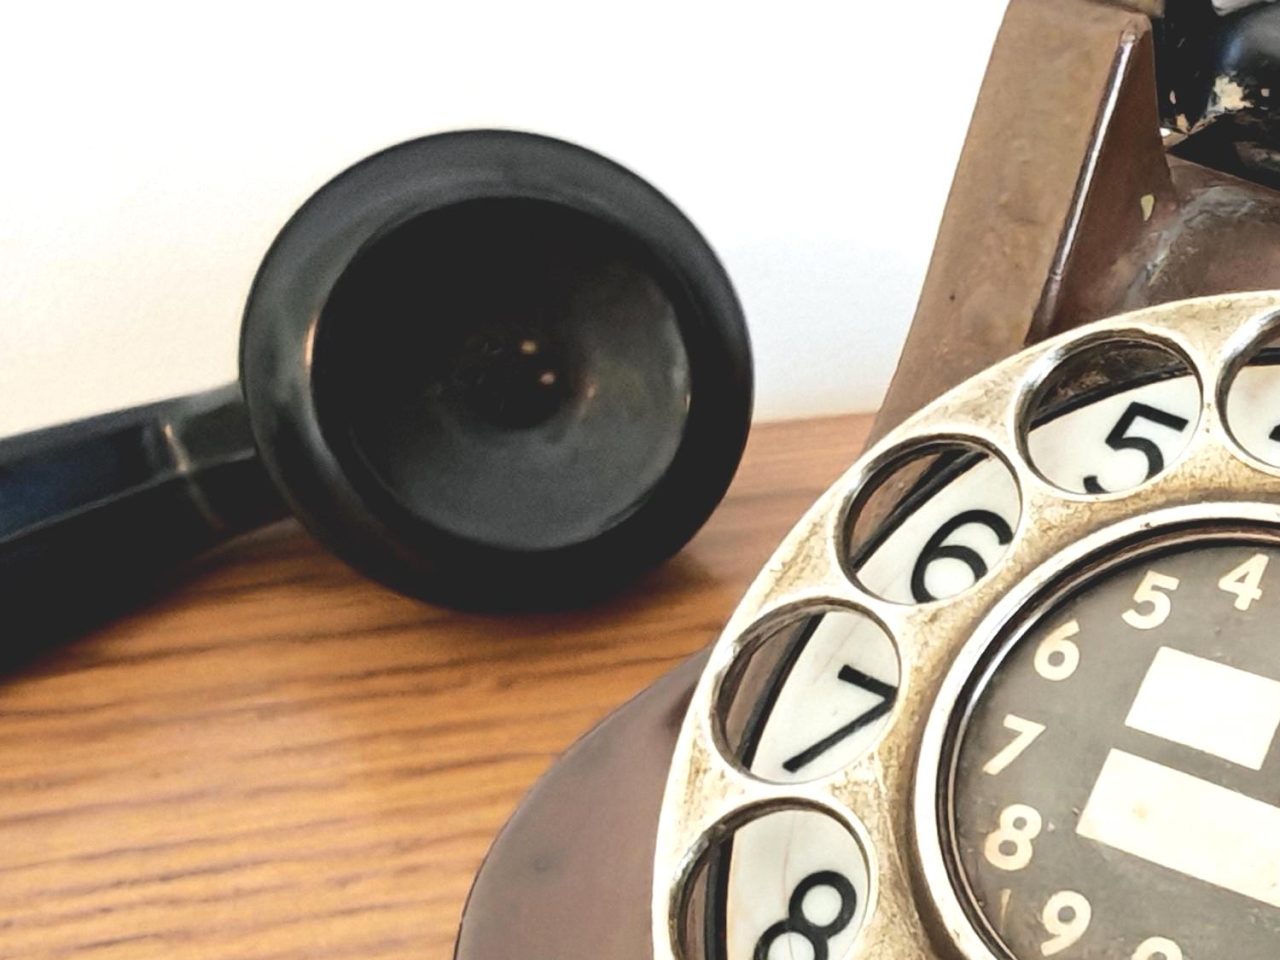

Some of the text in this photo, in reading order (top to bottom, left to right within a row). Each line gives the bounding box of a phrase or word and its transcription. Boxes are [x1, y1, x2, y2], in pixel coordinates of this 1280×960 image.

[1083, 401, 1189, 495] 5
[911, 508, 1014, 604] 6
[1218, 553, 1270, 611] 4
[1121, 570, 1179, 629] 5
[1033, 619, 1081, 681] 6
[782, 664, 898, 773] 7
[983, 713, 1046, 776] 7
[984, 804, 1043, 871] 8
[1040, 890, 1092, 957] 9
